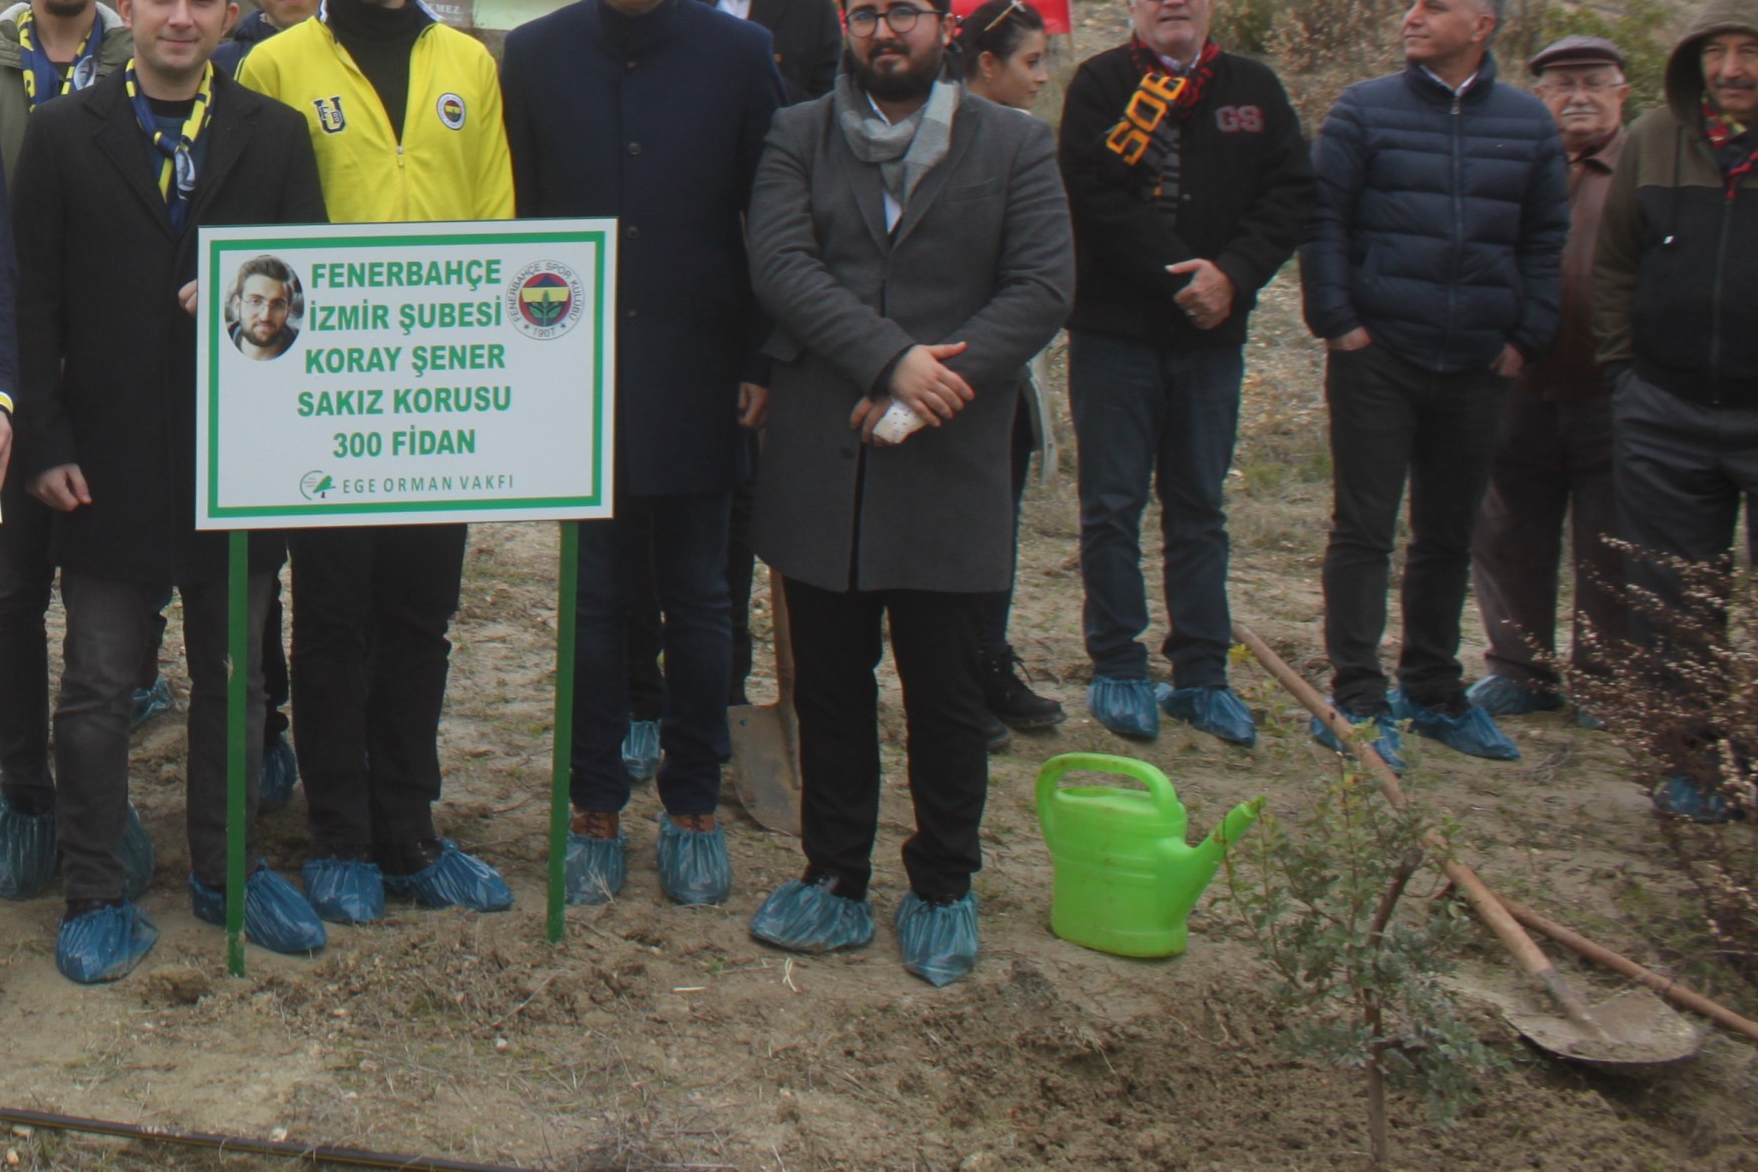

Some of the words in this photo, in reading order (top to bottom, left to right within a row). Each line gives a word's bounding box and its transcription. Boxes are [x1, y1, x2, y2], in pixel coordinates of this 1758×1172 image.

[1215, 105, 1264, 133] GS
[311, 259, 502, 292] FENERBAHÇE
[309, 299, 390, 332] İZMİR
[398, 295, 502, 336] ŞUBESİ
[305, 346, 403, 375] KORAY
[411, 343, 506, 378] ŞENER
[297, 389, 385, 418] SAKIZ
[393, 385, 512, 415] KORUSU
[333, 431, 383, 459] 300
[392, 425, 477, 457] FİDAN
[342, 478, 376, 494] EGE
[383, 476, 453, 493] ORMAN
[459, 474, 514, 490] VAKFI
